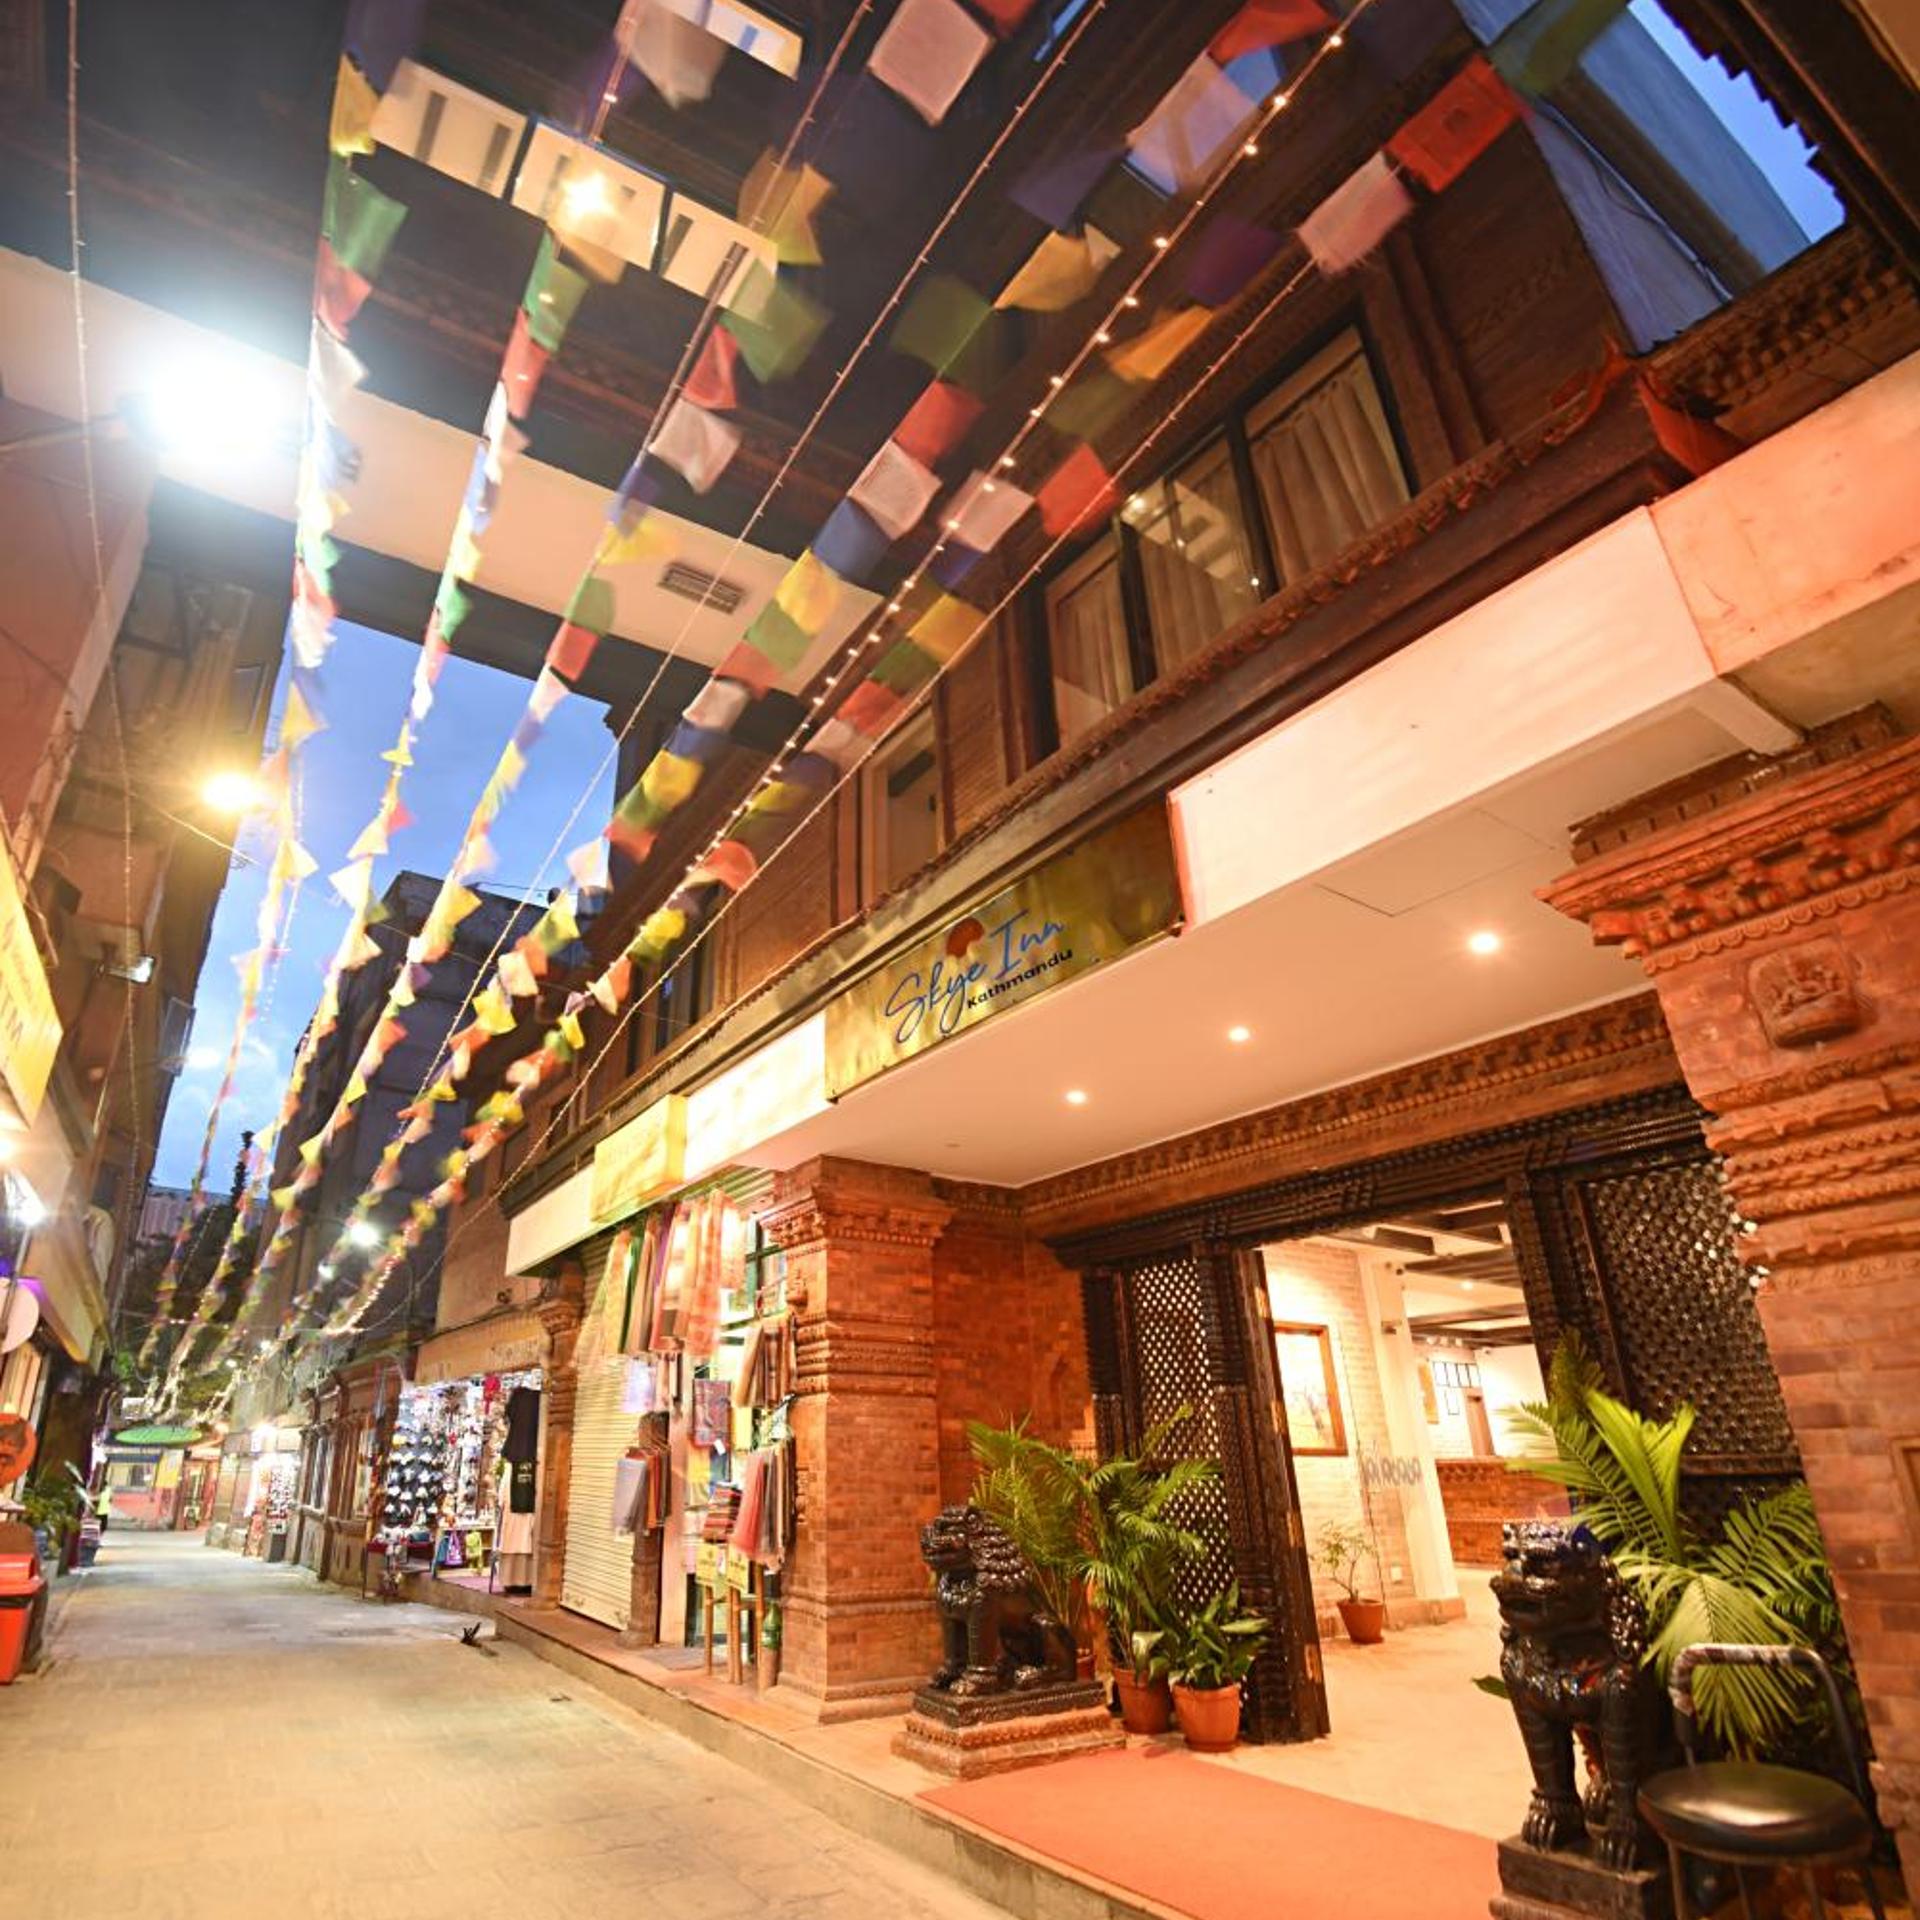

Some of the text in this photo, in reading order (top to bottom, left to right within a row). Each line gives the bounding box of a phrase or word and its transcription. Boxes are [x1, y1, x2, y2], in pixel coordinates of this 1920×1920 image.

[884, 909, 1064, 1044] Skye Inn
[967, 949, 1073, 1009] Kathmandu
